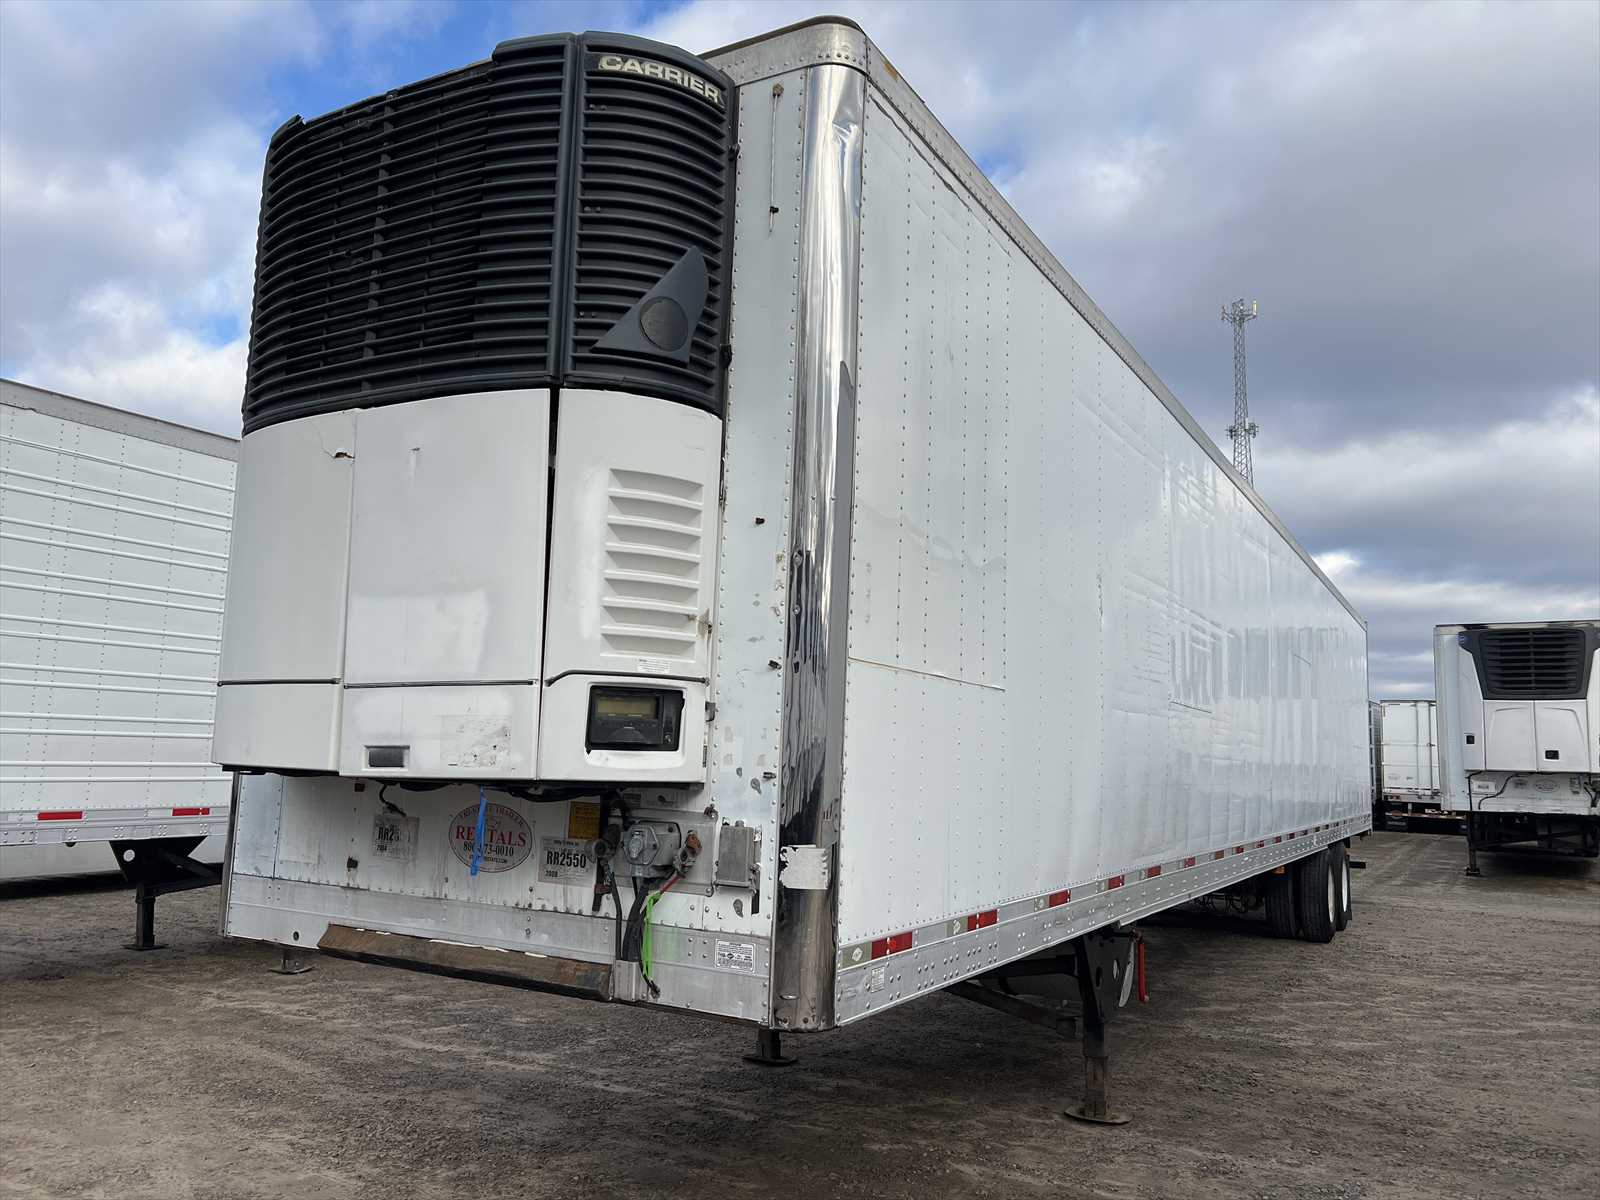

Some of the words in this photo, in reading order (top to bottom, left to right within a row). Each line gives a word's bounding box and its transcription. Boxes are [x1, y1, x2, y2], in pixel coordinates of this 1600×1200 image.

[598, 55, 725, 110] CARRIER
[455, 825, 526, 847] RETALS
[546, 850, 587, 869] RR2550
